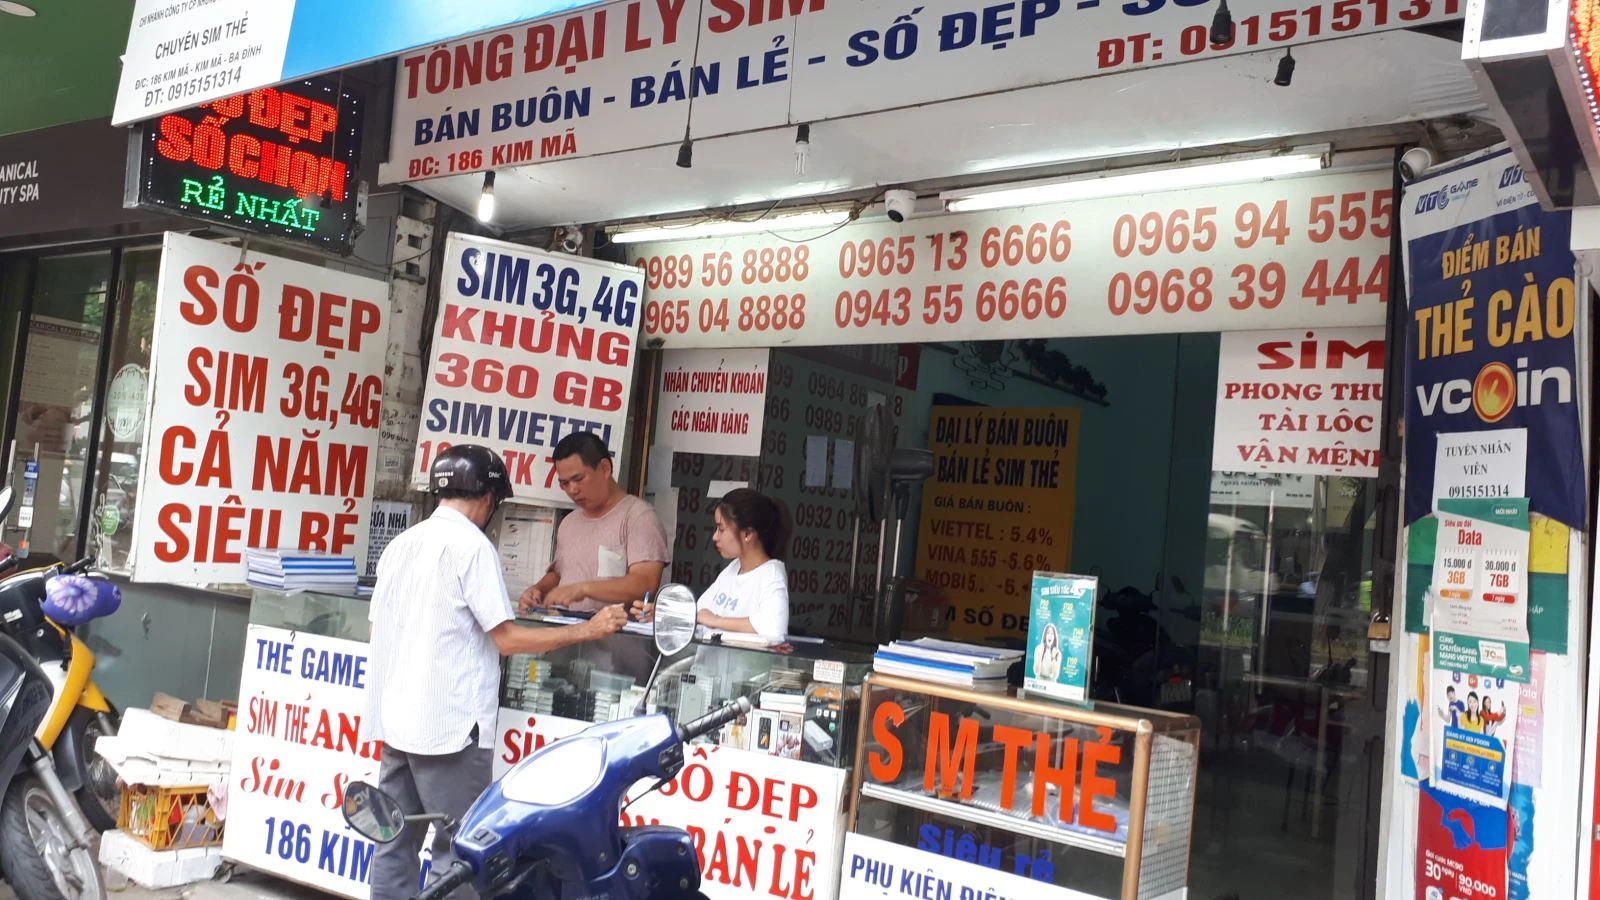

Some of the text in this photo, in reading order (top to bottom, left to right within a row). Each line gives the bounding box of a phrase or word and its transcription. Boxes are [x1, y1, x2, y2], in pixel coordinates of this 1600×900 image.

[155, 10, 248, 60] CHUYÊN SIM THẺ
[524, 9, 607, 75] ĐẠI
[1097, 32, 1162, 69] ĐT:
[144, 65, 242, 108] ĐT: 0915151314
[150, 73, 162, 86] 186
[163, 69, 176, 81] KIM
[195, 60, 209, 73] KIM
[228, 52, 240, 64] BA
[414, 0, 1060, 146] BÁN BUÔN BÁN LẺ SỐ ĐẸP
[248, 87, 339, 144] ĐẸP
[157, 114, 348, 202] SỐ CHỌN
[409, 127, 577, 178] ĐC: 186 KIM MÃ
[19, 183, 39, 202] SPA
[181, 175, 320, 231] RẺ NHẤT
[1450, 178, 1478, 195] GAME
[701, 251, 732, 287] 56
[741, 244, 809, 285] 8888
[839, 235, 915, 278] 0965
[930, 230, 969, 271] 13
[980, 220, 1071, 268] 6666
[1112, 207, 1217, 258] 0965
[1234, 200, 1290, 249] 94
[1308, 189, 1392, 243] 555
[1441, 225, 1540, 280] ĐIỂM BÁN
[457, 247, 530, 306] SIM
[698, 298, 730, 333] 04
[738, 293, 806, 331] 8888
[834, 287, 911, 329] 0943
[922, 283, 963, 325] 55
[975, 276, 1067, 321] 6666
[1108, 267, 1214, 316] 0968
[1228, 261, 1286, 310] 39
[1301, 254, 1390, 306] 444
[180, 262, 381, 359] SỐ ĐẸP
[1415, 271, 1575, 360] THẺ CÀO
[441, 304, 631, 367] KHỦNG
[184, 347, 269, 414] SIM
[280, 362, 383, 431] 3G,4G
[435, 352, 623, 412] 360 GB
[663, 365, 689, 398] NHẬN
[690, 358, 729, 392] CHUYỂN
[1225, 383, 1322, 401] PHONG
[426, 398, 493, 438] SIM
[671, 404, 749, 435] CÁC NGÂN HÀNG
[936, 415, 961, 449] ĐẠI
[964, 411, 983, 445] LÝ
[985, 411, 1019, 446] BÁN
[1022, 412, 1069, 449] BUÔN
[1259, 406, 1308, 432] TÀI
[159, 410, 233, 489] CẢ
[252, 428, 369, 499] NĂM
[503, 449, 536, 486] TK
[1237, 437, 1299, 469] VẬN
[1463, 460, 1488, 476] VIÊN
[1480, 439, 1511, 455] NHÂN
[937, 448, 1060, 490] BÁN LẺ SIM THẺ
[934, 494, 954, 508] GIÁ
[959, 496, 984, 511] BÁN
[1448, 484, 1510, 498] 0915151314
[154, 494, 282, 564] SIÊU
[298, 497, 359, 555] RẺ
[930, 518, 994, 541] VIETTEL
[1458, 529, 1483, 546] Data
[927, 544, 966, 564] VINA
[1444, 558, 1510, 571] 15.000 30.000
[926, 569, 966, 590] MOBI
[1447, 570, 1509, 588] 3GB 7GB
[963, 605, 995, 626] SỐ
[256, 630, 367, 689] THẺ GAME
[240, 756, 306, 804] Sim
[993, 726, 1121, 833] THẺ
[725, 770, 818, 835] ĐẸP
[265, 816, 311, 864] 186
[685, 817, 817, 900] BÁN LẺ
[850, 854, 894, 896] PHỤ
[1425, 859, 1441, 880] 30
[1458, 873, 1496, 897] 90.000
